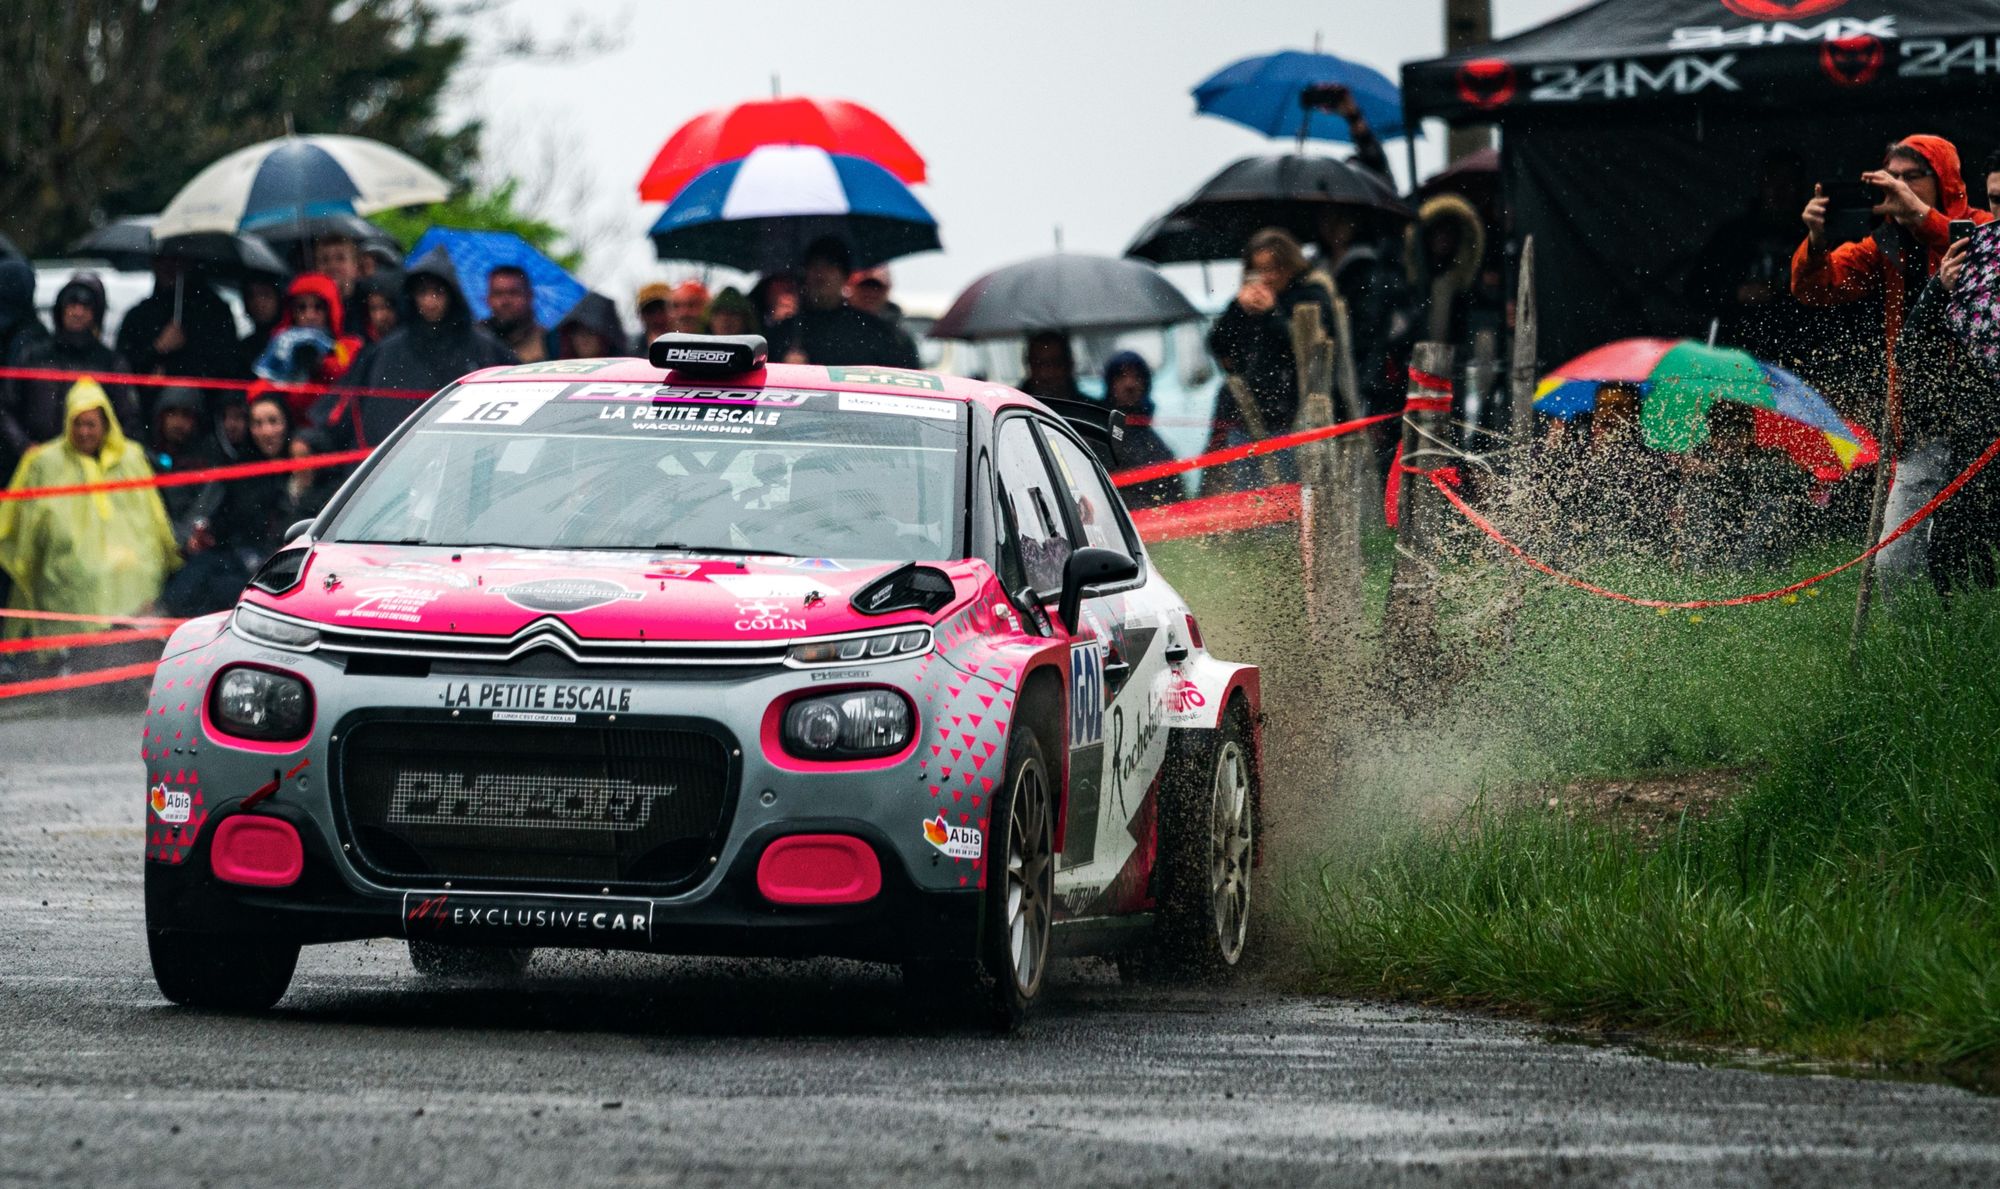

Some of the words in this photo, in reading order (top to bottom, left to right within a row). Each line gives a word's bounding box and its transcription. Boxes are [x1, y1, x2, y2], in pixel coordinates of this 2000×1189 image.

[1899, 37, 2000, 75] 24
[1531, 54, 1741, 100] 24MX
[462, 401, 519, 421] 16
[600, 406, 626, 419] LA
[633, 406, 699, 421] PETITE
[703, 408, 781, 426] ESCALE
[632, 423, 754, 434] WACQUINGHEN
[735, 619, 807, 631] COLIN
[445, 683, 471, 707] LA
[479, 683, 548, 708] PETITE
[553, 685, 632, 712] ESCALE
[1069, 647, 1102, 746] IGOL
